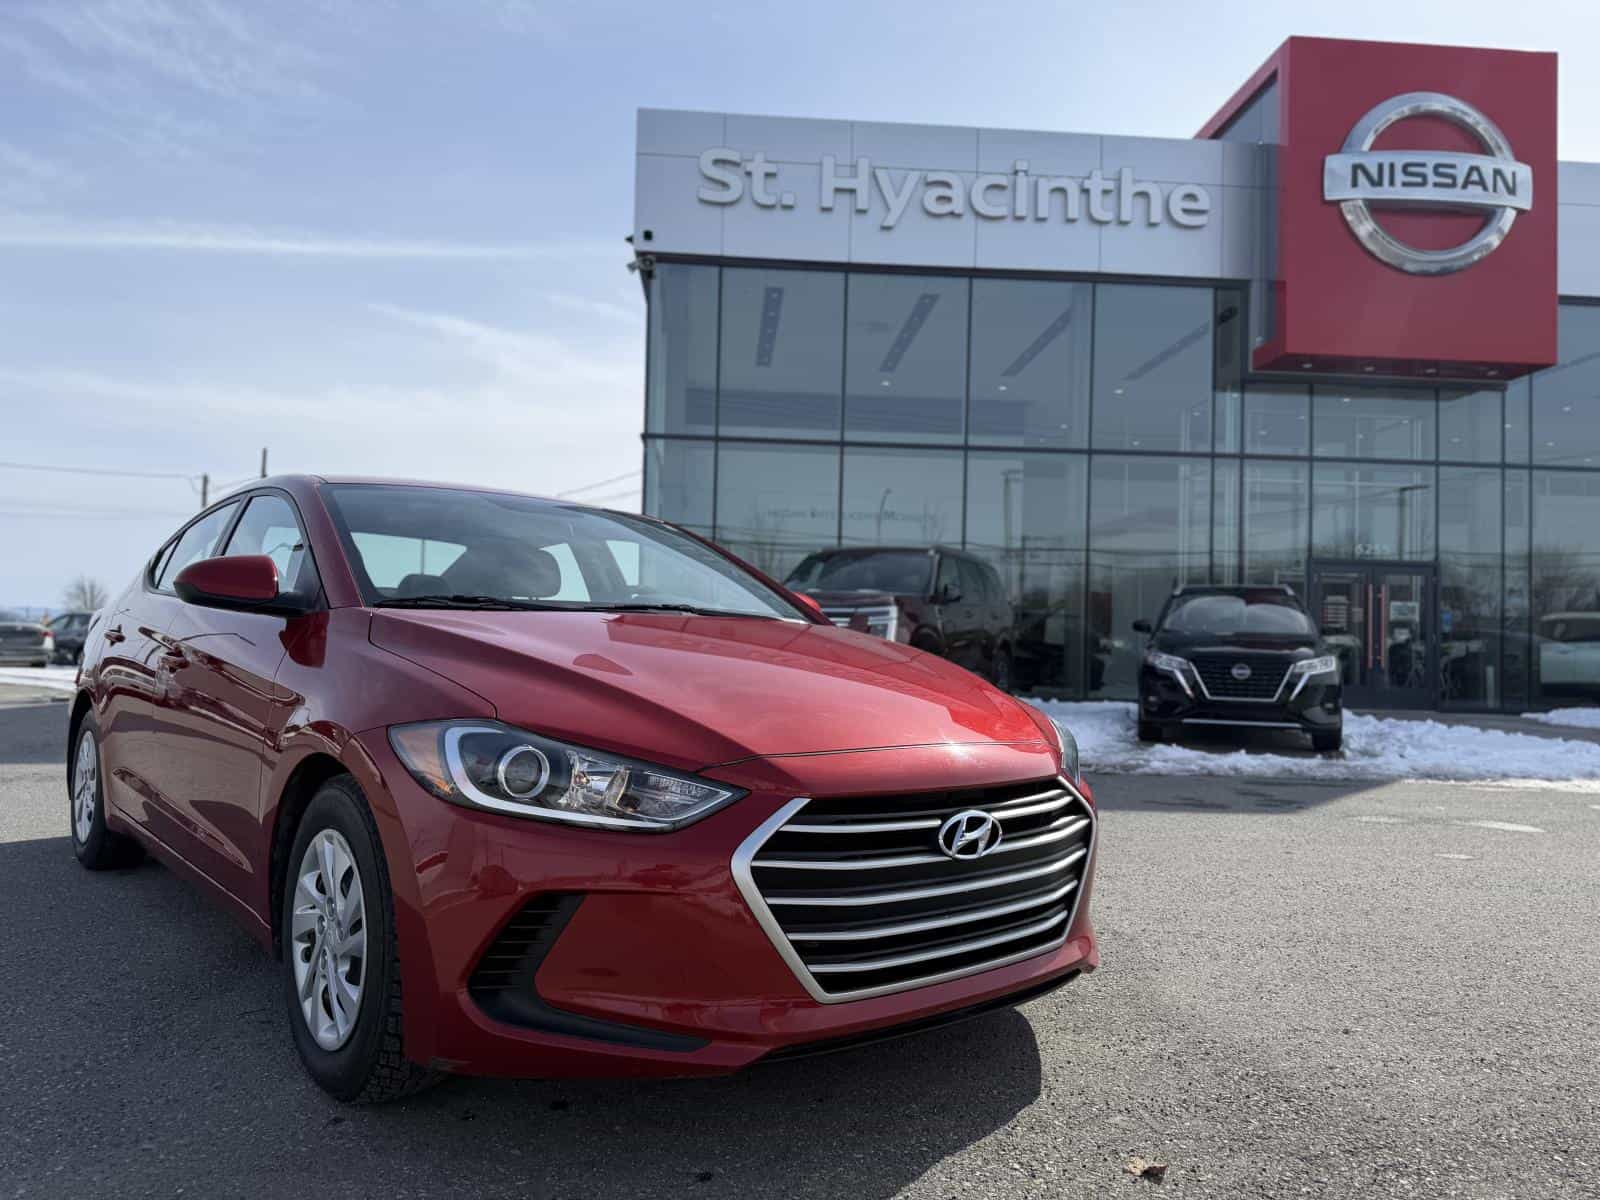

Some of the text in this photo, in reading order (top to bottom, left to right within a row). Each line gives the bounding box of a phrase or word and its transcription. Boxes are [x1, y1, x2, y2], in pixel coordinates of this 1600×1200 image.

[697, 147, 1211, 229] St. Hyacinthe
[1351, 161, 1517, 197] NISSAN
